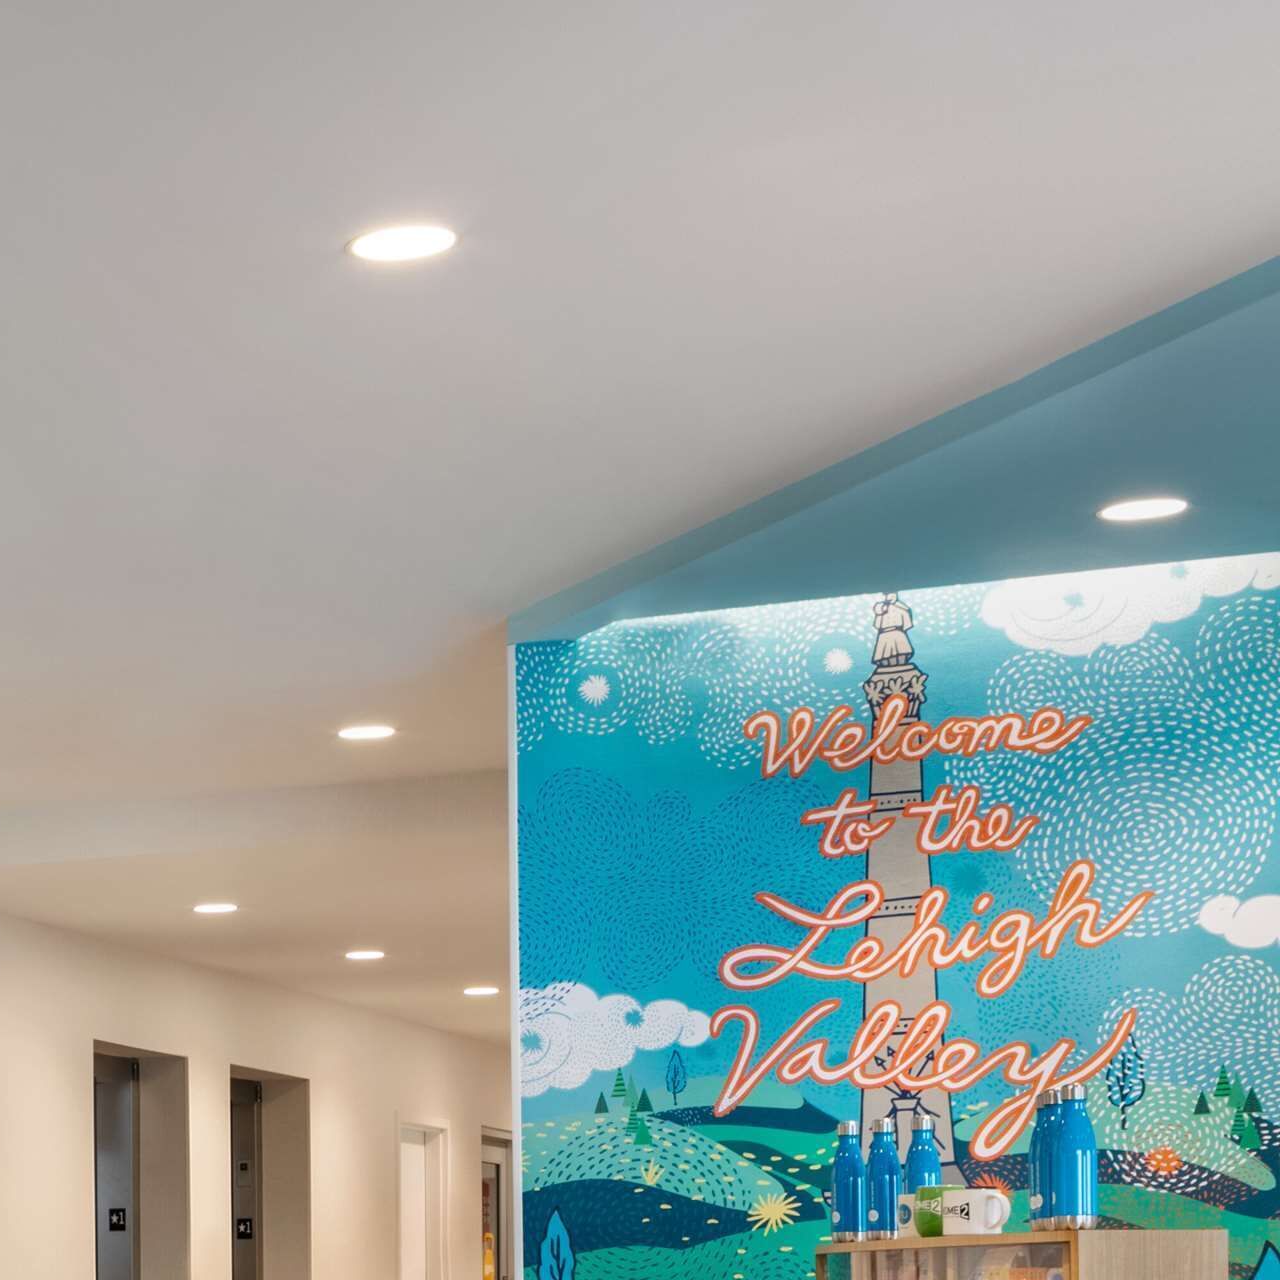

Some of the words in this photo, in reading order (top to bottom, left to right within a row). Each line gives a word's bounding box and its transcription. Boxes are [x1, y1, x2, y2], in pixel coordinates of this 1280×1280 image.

[744, 694, 1094, 778] Welcome
[802, 788, 895, 859] to
[903, 785, 1040, 856] the
[719, 860, 1155, 998] Lehigh
[709, 999, 1138, 1162] Valley
